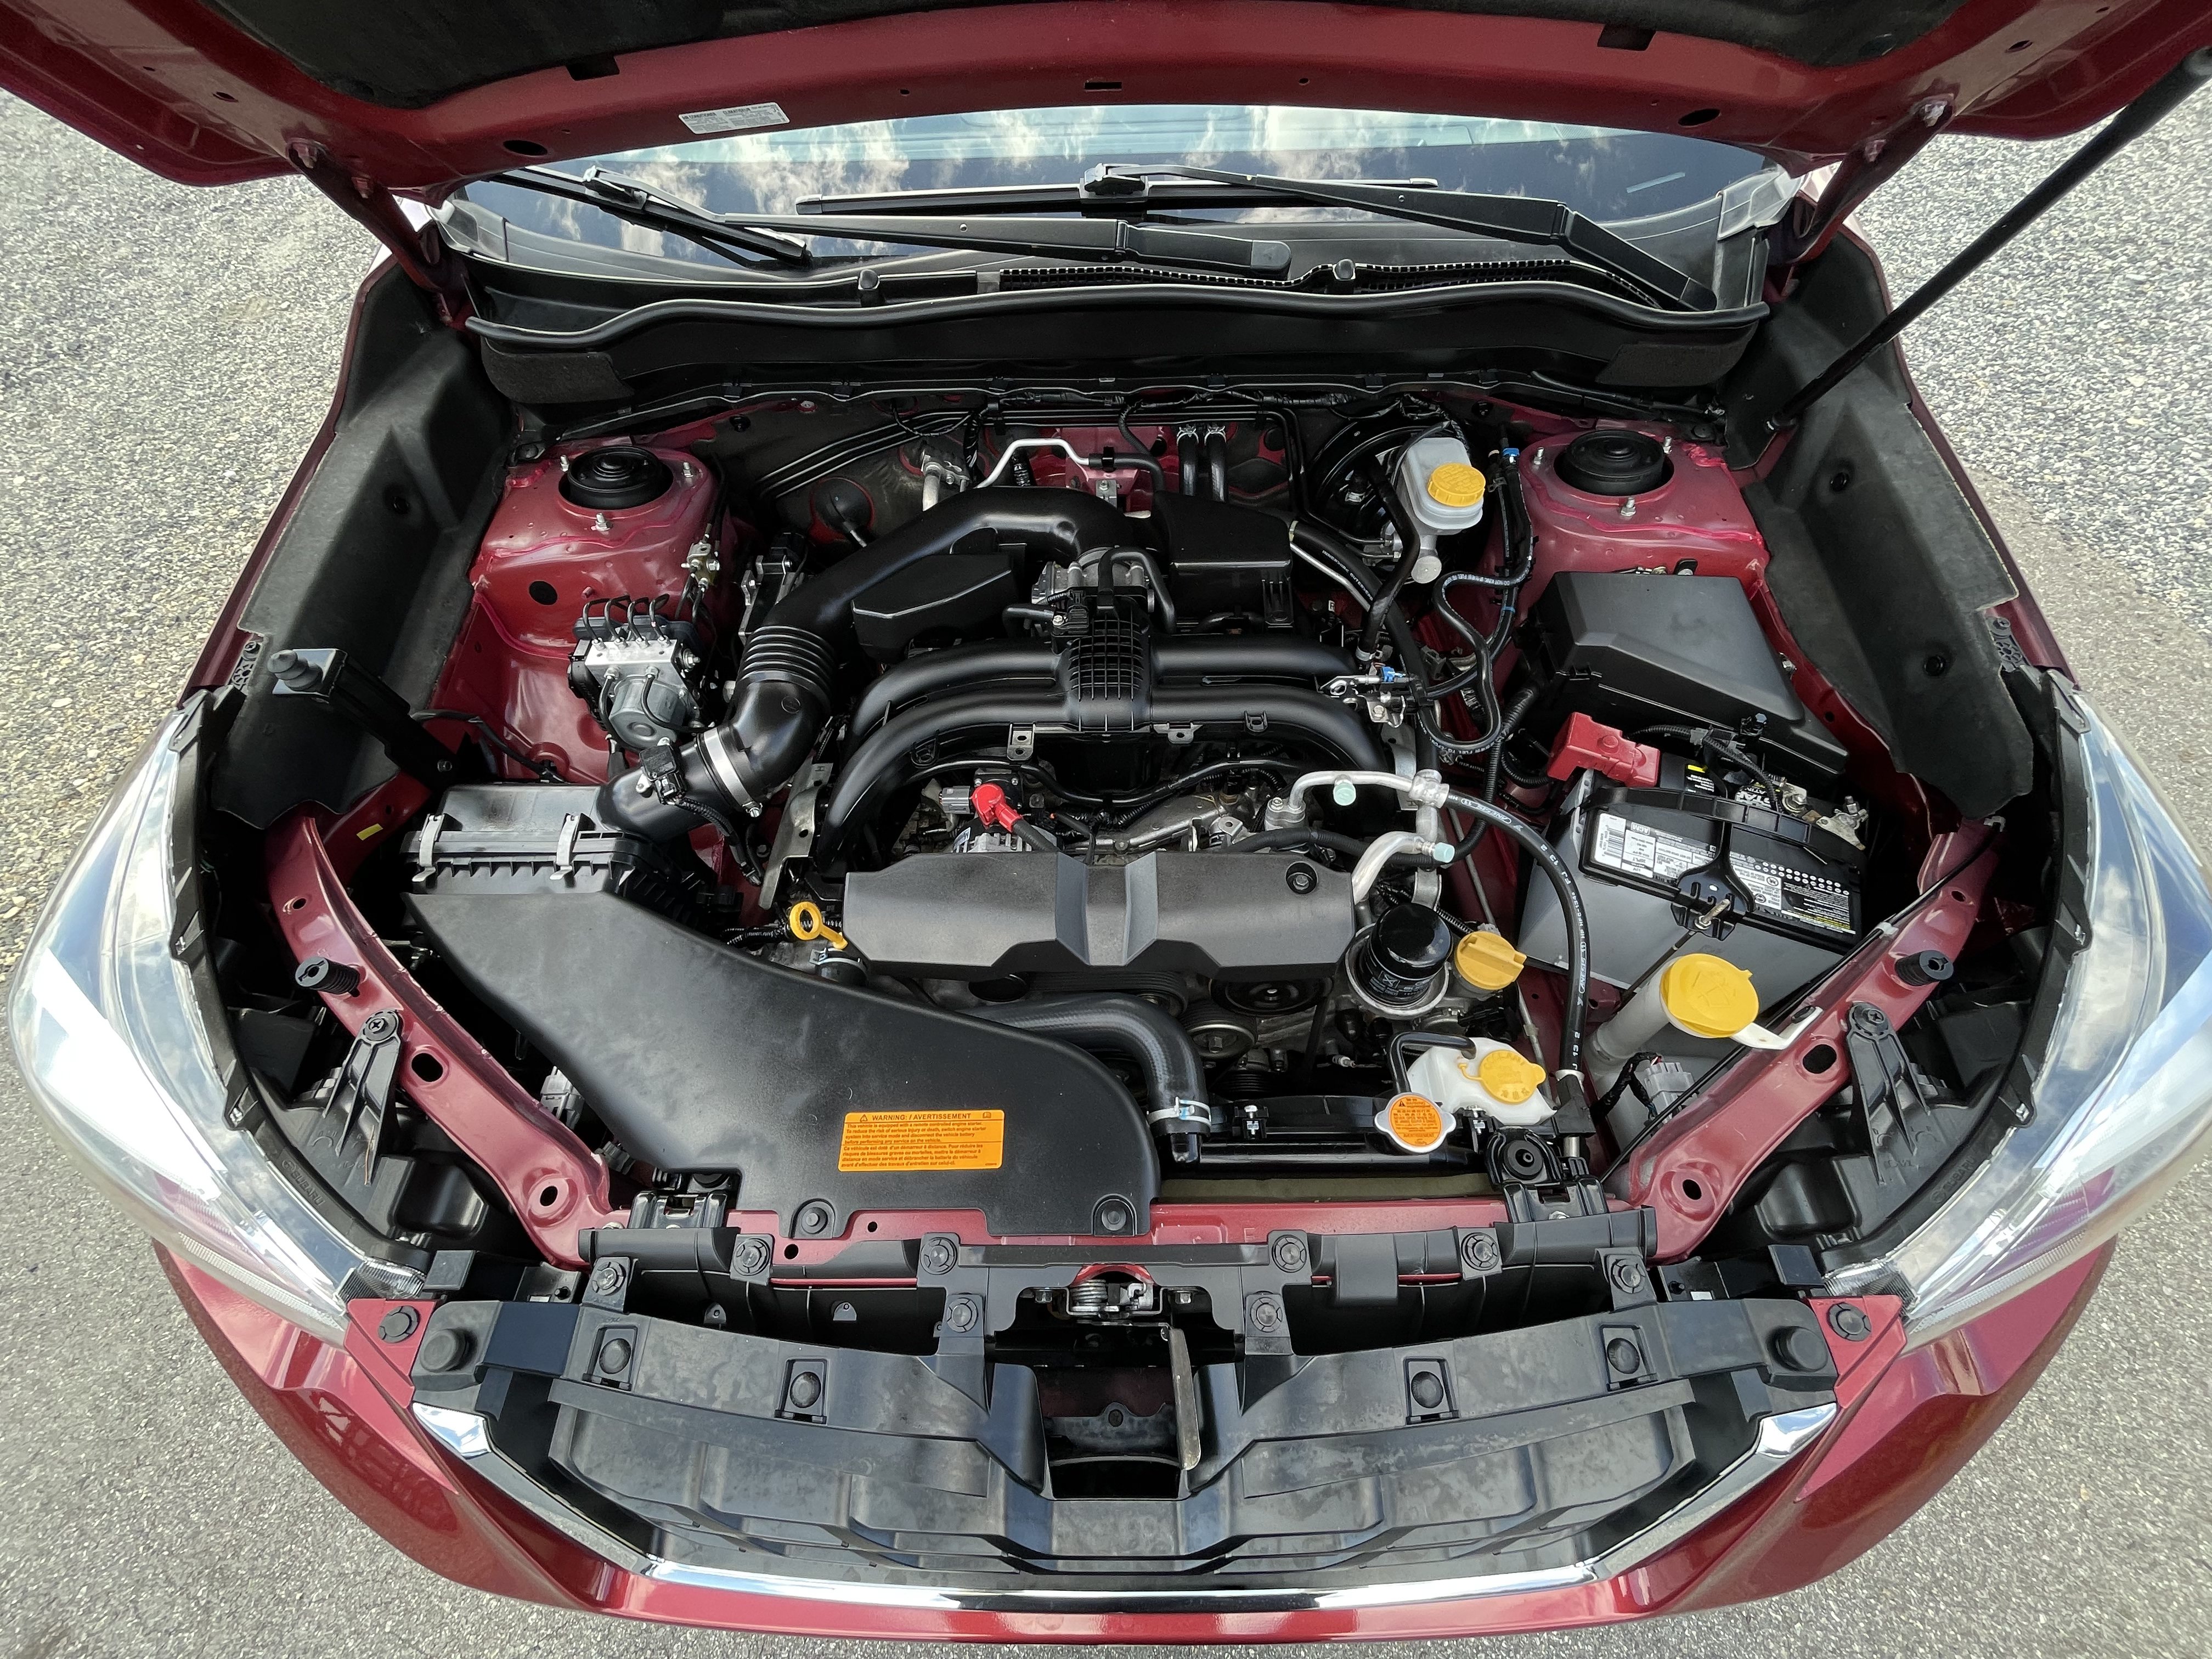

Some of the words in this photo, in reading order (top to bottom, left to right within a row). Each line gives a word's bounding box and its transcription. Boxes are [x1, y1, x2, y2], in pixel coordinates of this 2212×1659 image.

[1632, 823, 1649, 833] AGM
[291, 1172, 325, 1205] SUBARU
[1943, 1156, 1975, 1191] SUBARU
